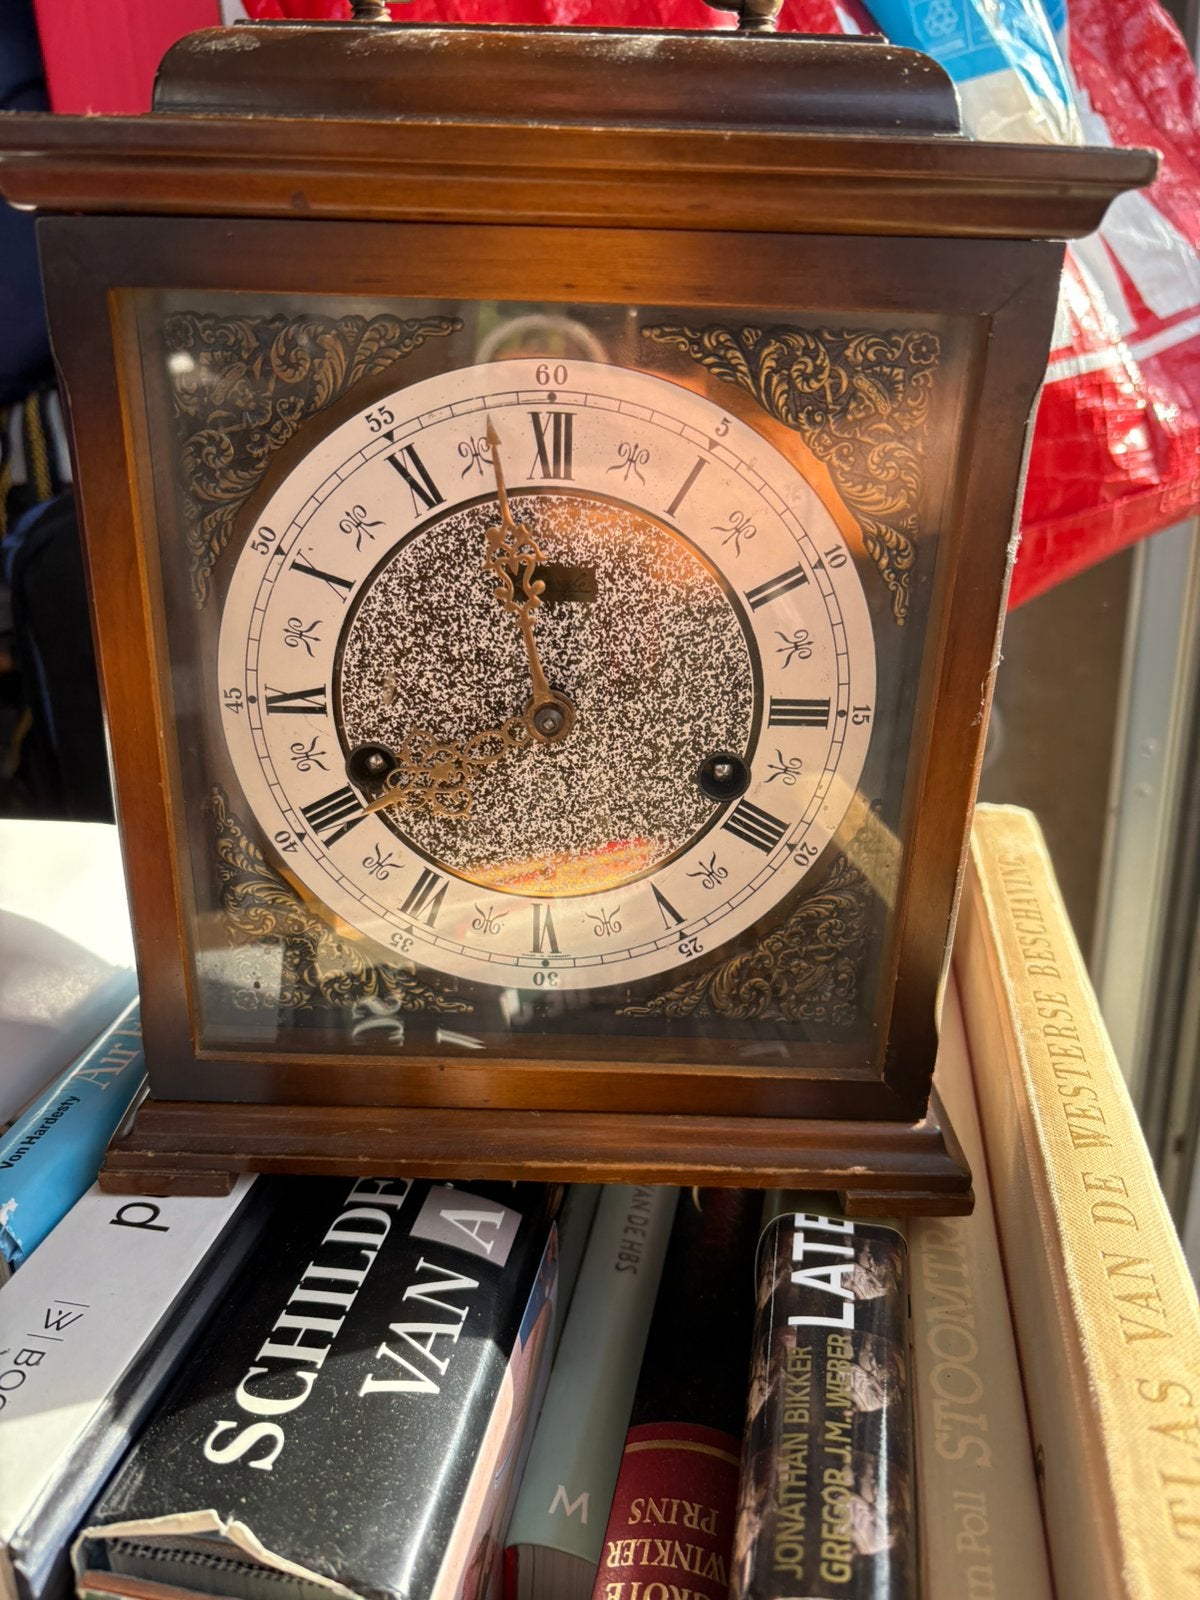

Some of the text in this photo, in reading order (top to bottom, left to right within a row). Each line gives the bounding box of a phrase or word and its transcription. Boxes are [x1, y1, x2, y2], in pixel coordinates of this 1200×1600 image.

[535, 364, 568, 386] 60
[365, 405, 395, 433] 55
[715, 417, 733, 438] 5
[526, 411, 578, 481] XII
[384, 442, 447, 519] XI
[663, 455, 711, 519] I
[250, 526, 277, 556] 50
[823, 543, 848, 569] 10
[288, 548, 357, 604] X
[743, 561, 810, 613] II
[223, 687, 244, 715] 45
[264, 682, 328, 717] IX
[767, 695, 831, 731] III
[851, 704, 871, 726] 15
[299, 782, 370, 850] VIII
[720, 797, 792, 856] IIII
[274, 830, 298, 853] 40
[793, 842, 818, 867] 20
[397, 866, 449, 929] VII
[649, 882, 688, 930] V
[390, 932, 414, 953] 35
[532, 903, 560, 953] VI
[678, 936, 704, 959] 25
[533, 971, 558, 987] 30
[1033, 988, 1114, 1151] WESTERSE
[0, 1095, 80, 1170] Von Hardesty
[1082, 1171, 1139, 1231] DE
[623, 1214, 649, 1239] DE
[614, 1238, 644, 1275] HBS
[1101, 1251, 1173, 1346] VAN
[359, 1257, 480, 1397] VAN
[0, 1348, 46, 1411] BO
[825, 1333, 854, 1413] WEBER
[773, 1345, 813, 1580] JONATHAN BIKKER
[628, 1496, 720, 1536] PRINS
[819, 1468, 855, 1584] GREGOR
[953, 1491, 991, 1557] Poll
[606, 1538, 729, 1587] WINKLER
